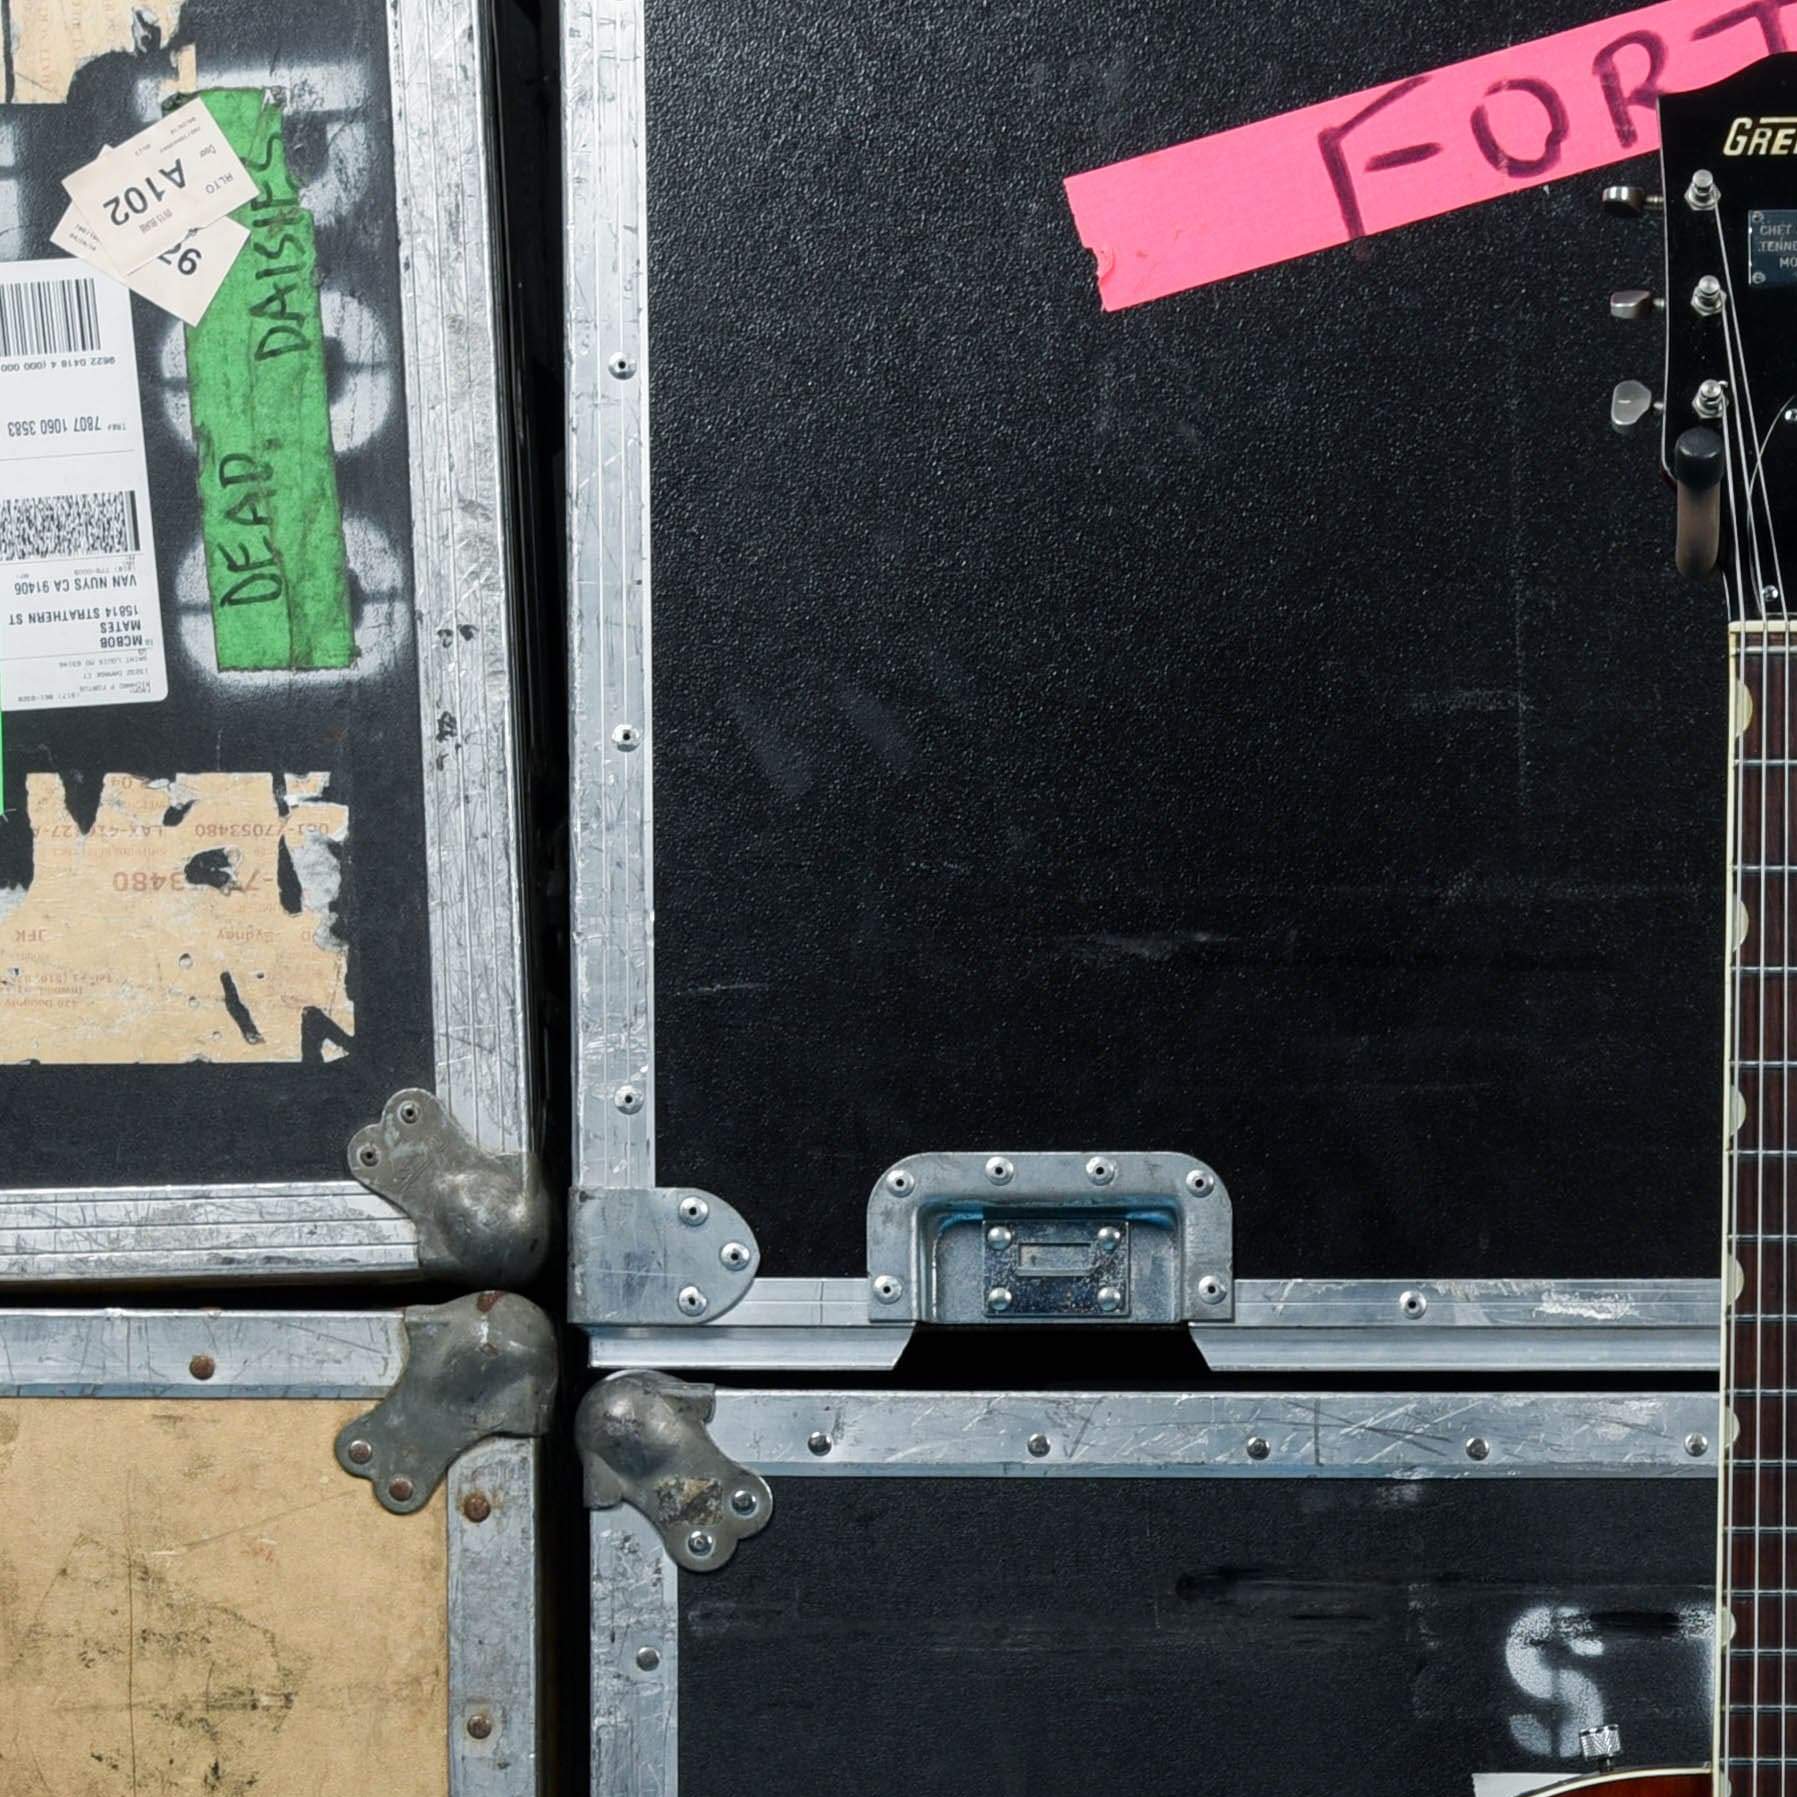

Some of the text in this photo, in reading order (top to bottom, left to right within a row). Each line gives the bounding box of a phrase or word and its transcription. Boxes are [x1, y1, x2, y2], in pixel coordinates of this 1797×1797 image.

[102, 158, 187, 226] A102
[1759, 222, 1792, 236] CHET
[7, 420, 37, 437] 3583
[40, 418, 68, 435] 1060
[73, 416, 102, 433] 7807
[14, 573, 137, 596] VAN NUYS CA 91406
[8, 604, 139, 626] 15814 STRATHERN ST
[100, 620, 142, 634] MATES
[100, 634, 143, 649] MCBOB
[14, 928, 47, 943] JFK
